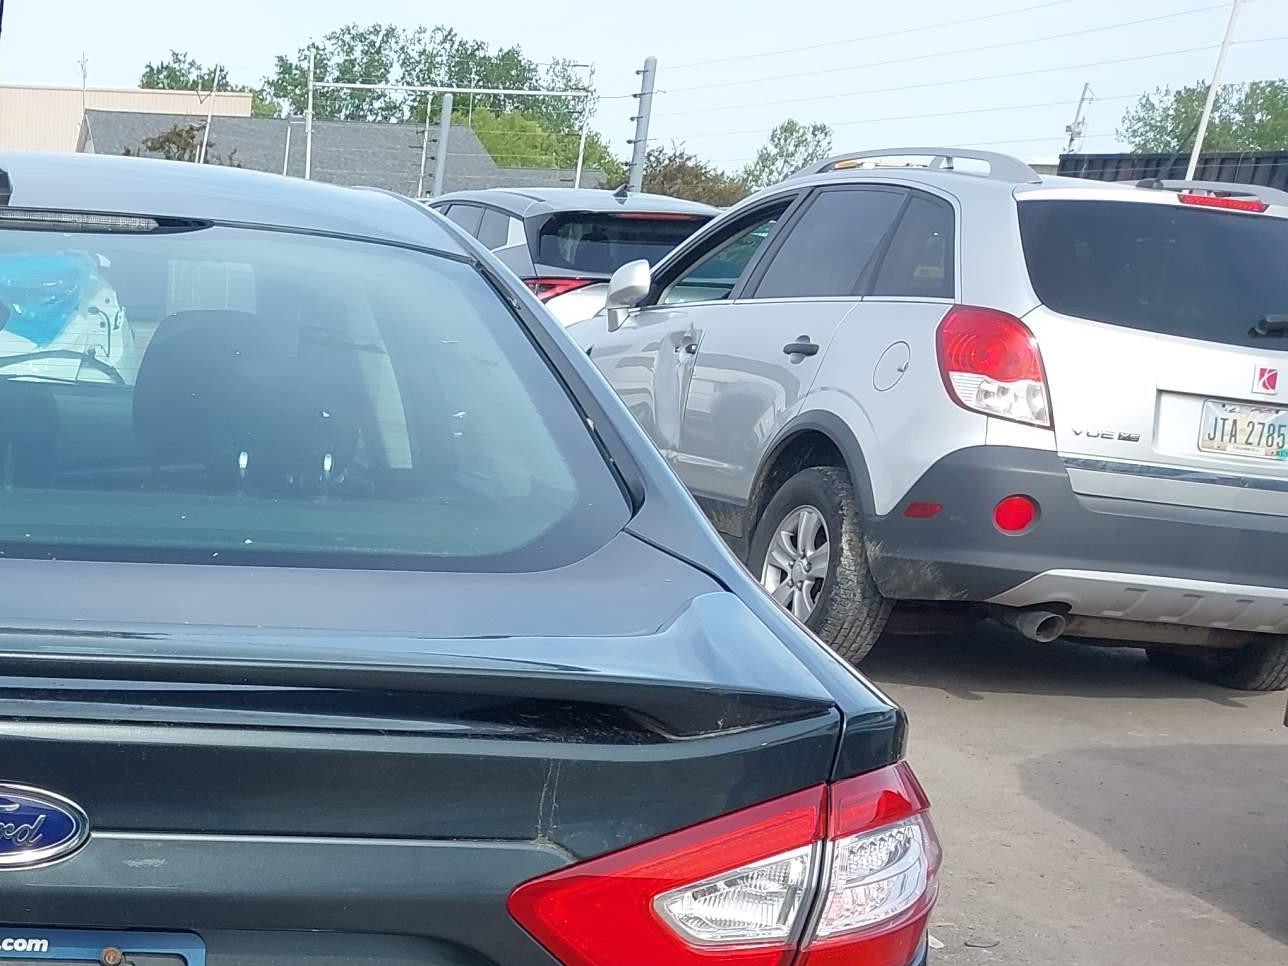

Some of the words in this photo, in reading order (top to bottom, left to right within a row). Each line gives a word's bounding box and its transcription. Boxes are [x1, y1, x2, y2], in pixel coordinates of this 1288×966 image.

[1071, 427, 1115, 440] VUE
[1207, 416, 1238, 443] JTA
[1245, 421, 1287, 449] 2785
